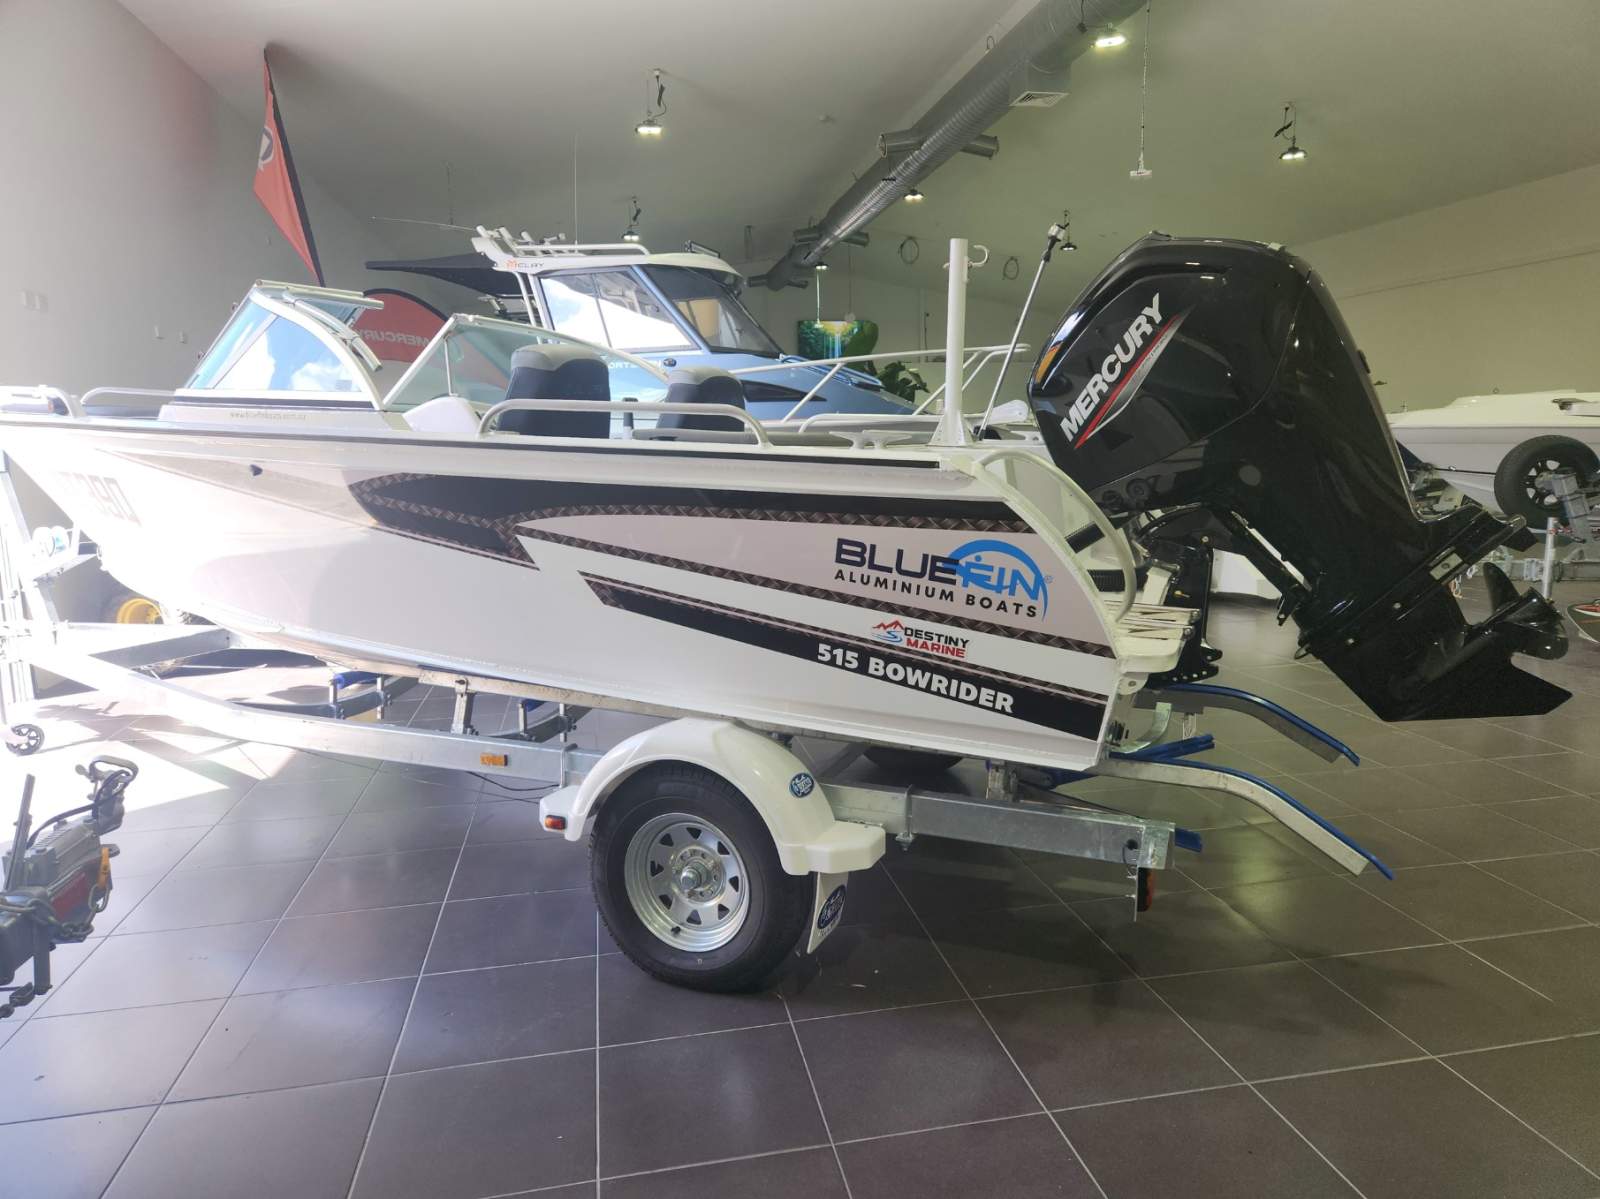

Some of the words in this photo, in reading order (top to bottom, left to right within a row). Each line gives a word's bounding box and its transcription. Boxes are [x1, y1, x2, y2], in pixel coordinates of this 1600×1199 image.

[1060, 292, 1163, 442] MERCURY
[834, 538, 1042, 601] BLUEFIN
[834, 569, 955, 602] ALUMINIUM
[965, 593, 1037, 618] BOATS
[904, 627, 970, 647] DESTINY
[906, 638, 966, 658] MARINE
[817, 643, 859, 669] 515
[868, 657, 1014, 713] BOWRIDER
